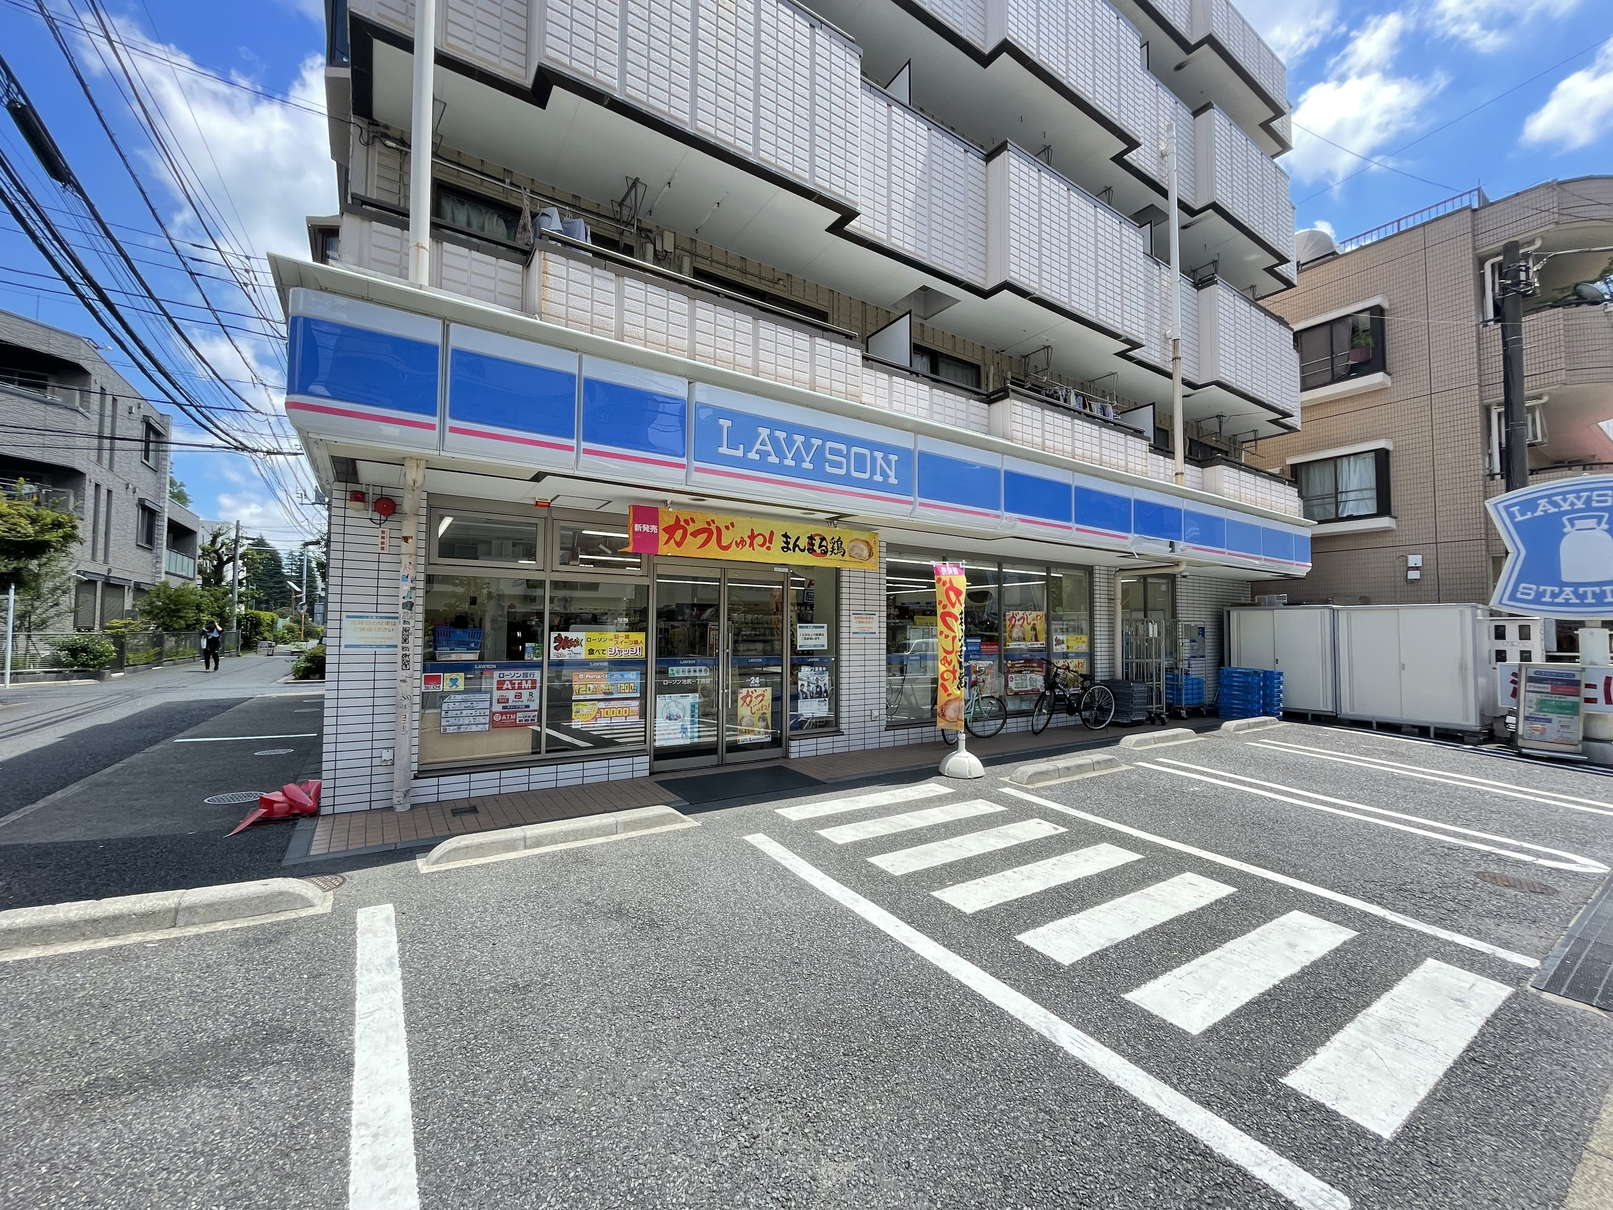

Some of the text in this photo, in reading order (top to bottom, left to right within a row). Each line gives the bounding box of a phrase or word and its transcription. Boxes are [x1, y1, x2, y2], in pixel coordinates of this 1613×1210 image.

[717, 418, 899, 485] LAWSON
[634, 522, 658, 535] 新発売
[588, 648, 606, 656] 食べて
[498, 671, 536, 679] ローソン銀行
[502, 680, 533, 690] ATM
